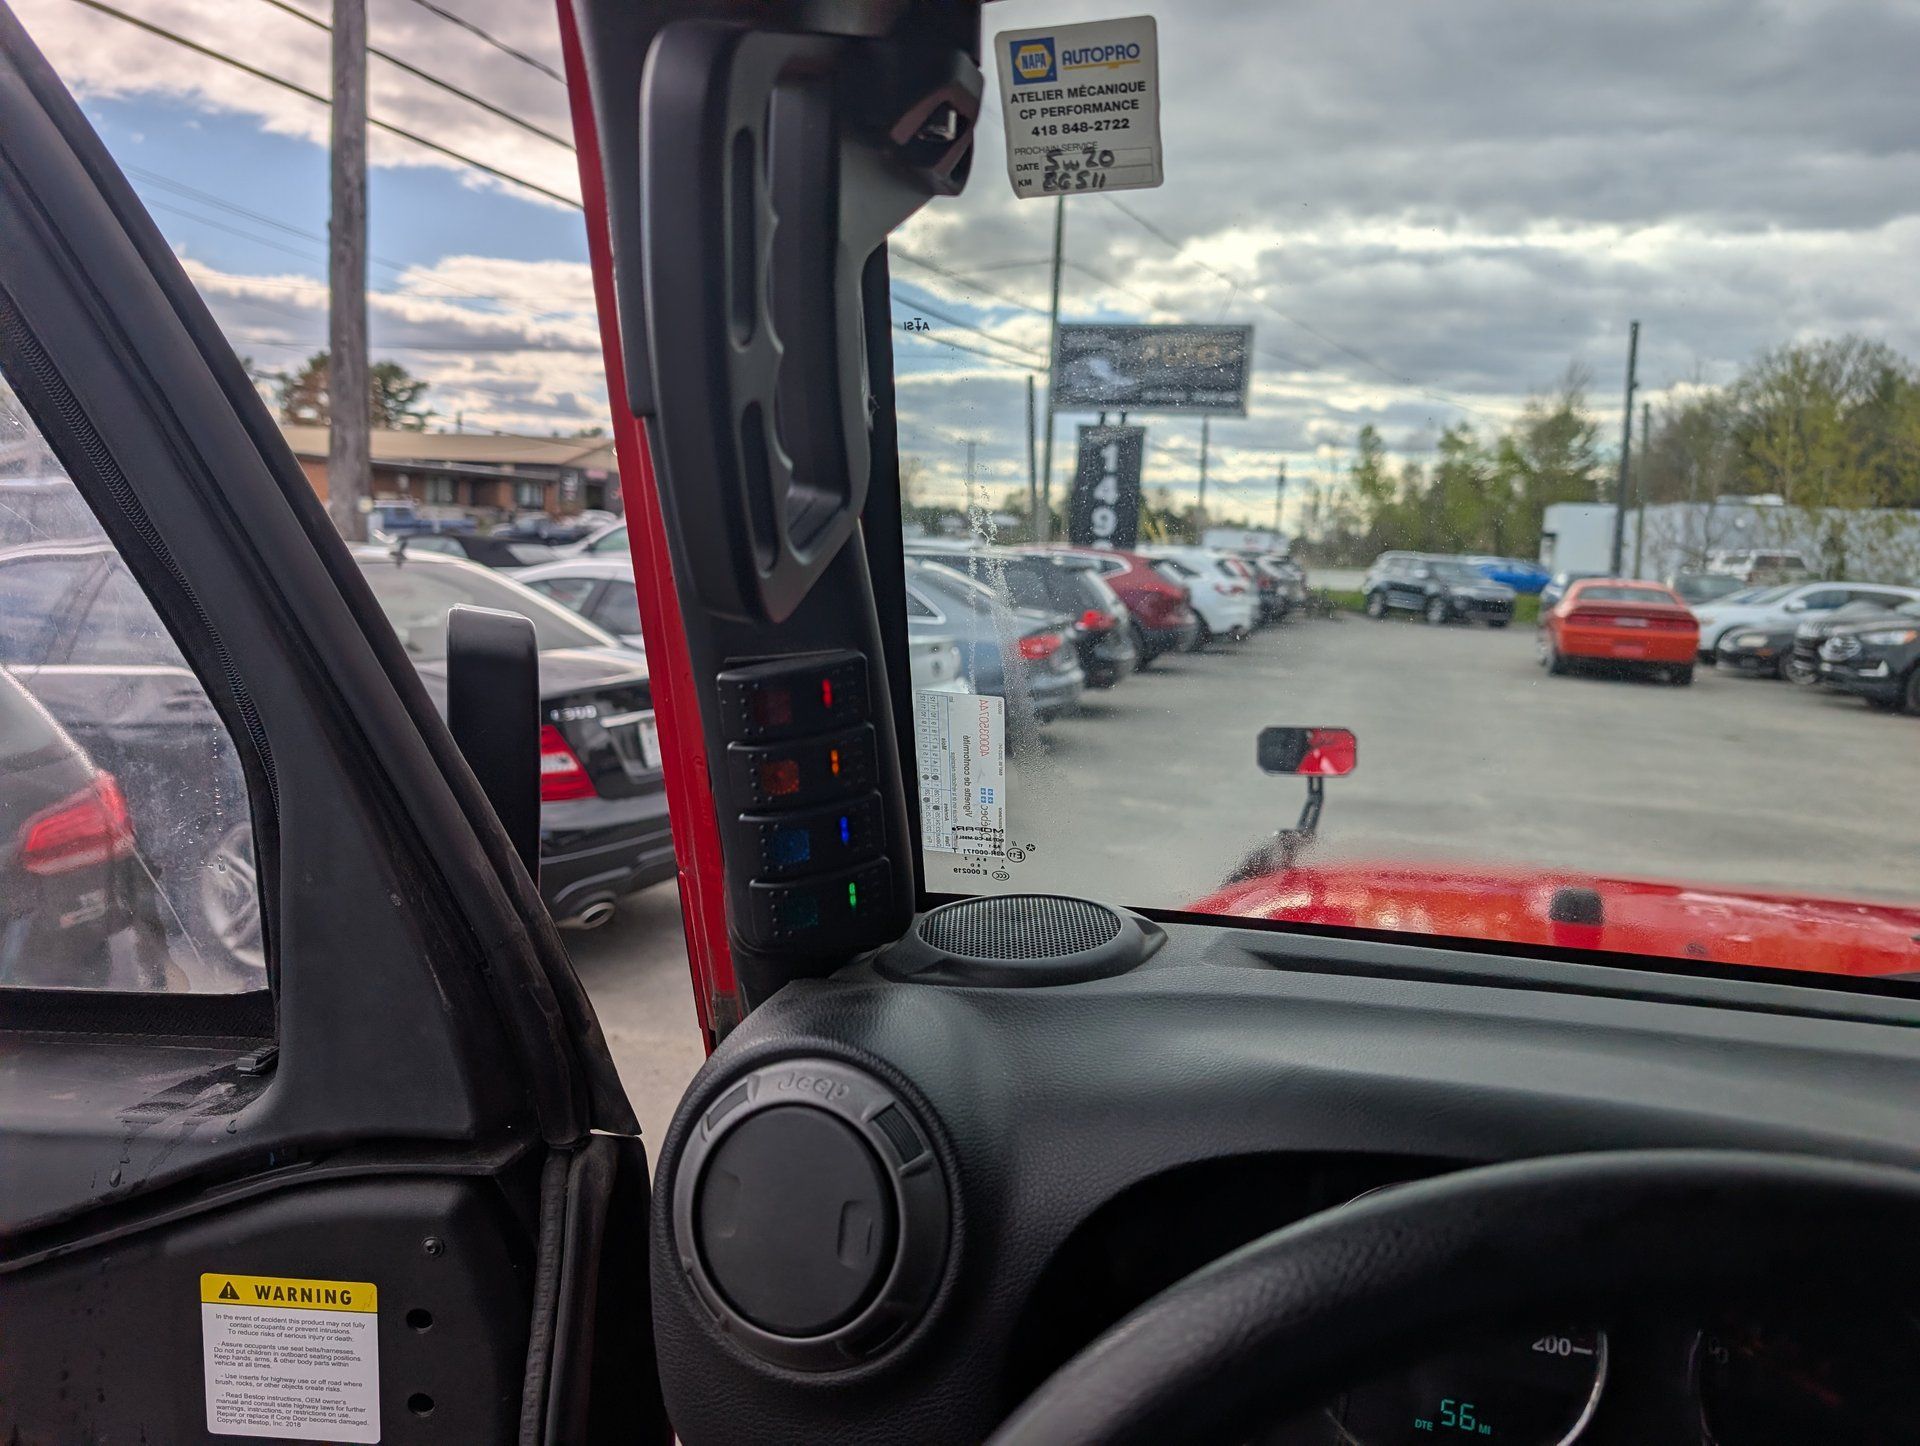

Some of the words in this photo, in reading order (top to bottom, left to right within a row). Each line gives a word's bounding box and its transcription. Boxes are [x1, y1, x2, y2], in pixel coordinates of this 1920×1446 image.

[1021, 53, 1047, 69] NAPA
[1062, 43, 1140, 65] AUTOPRO
[1011, 89, 1063, 104] ATELIER
[1067, 81, 1146, 98] MÉCANIQUE
[1020, 109, 1037, 120] CP
[1041, 99, 1139, 118] PERFORMANCE
[1031, 125, 1057, 137] 418
[1062, 118, 1130, 134] 848-2722
[1014, 144, 1060, 156] PROCHAIN
[1061, 141, 1098, 152] SERVICE
[1016, 162, 1039, 171] DATE
[1018, 179, 1032, 187] KM
[1091, 443, 1120, 550] 149
[777, 1071, 850, 1100] Jeep
[254, 1284, 352, 1305] WARNING
[1414, 1418, 1433, 1432] DTE
[1440, 1398, 1476, 1431] 56
[1479, 1422, 1491, 1435] MI
